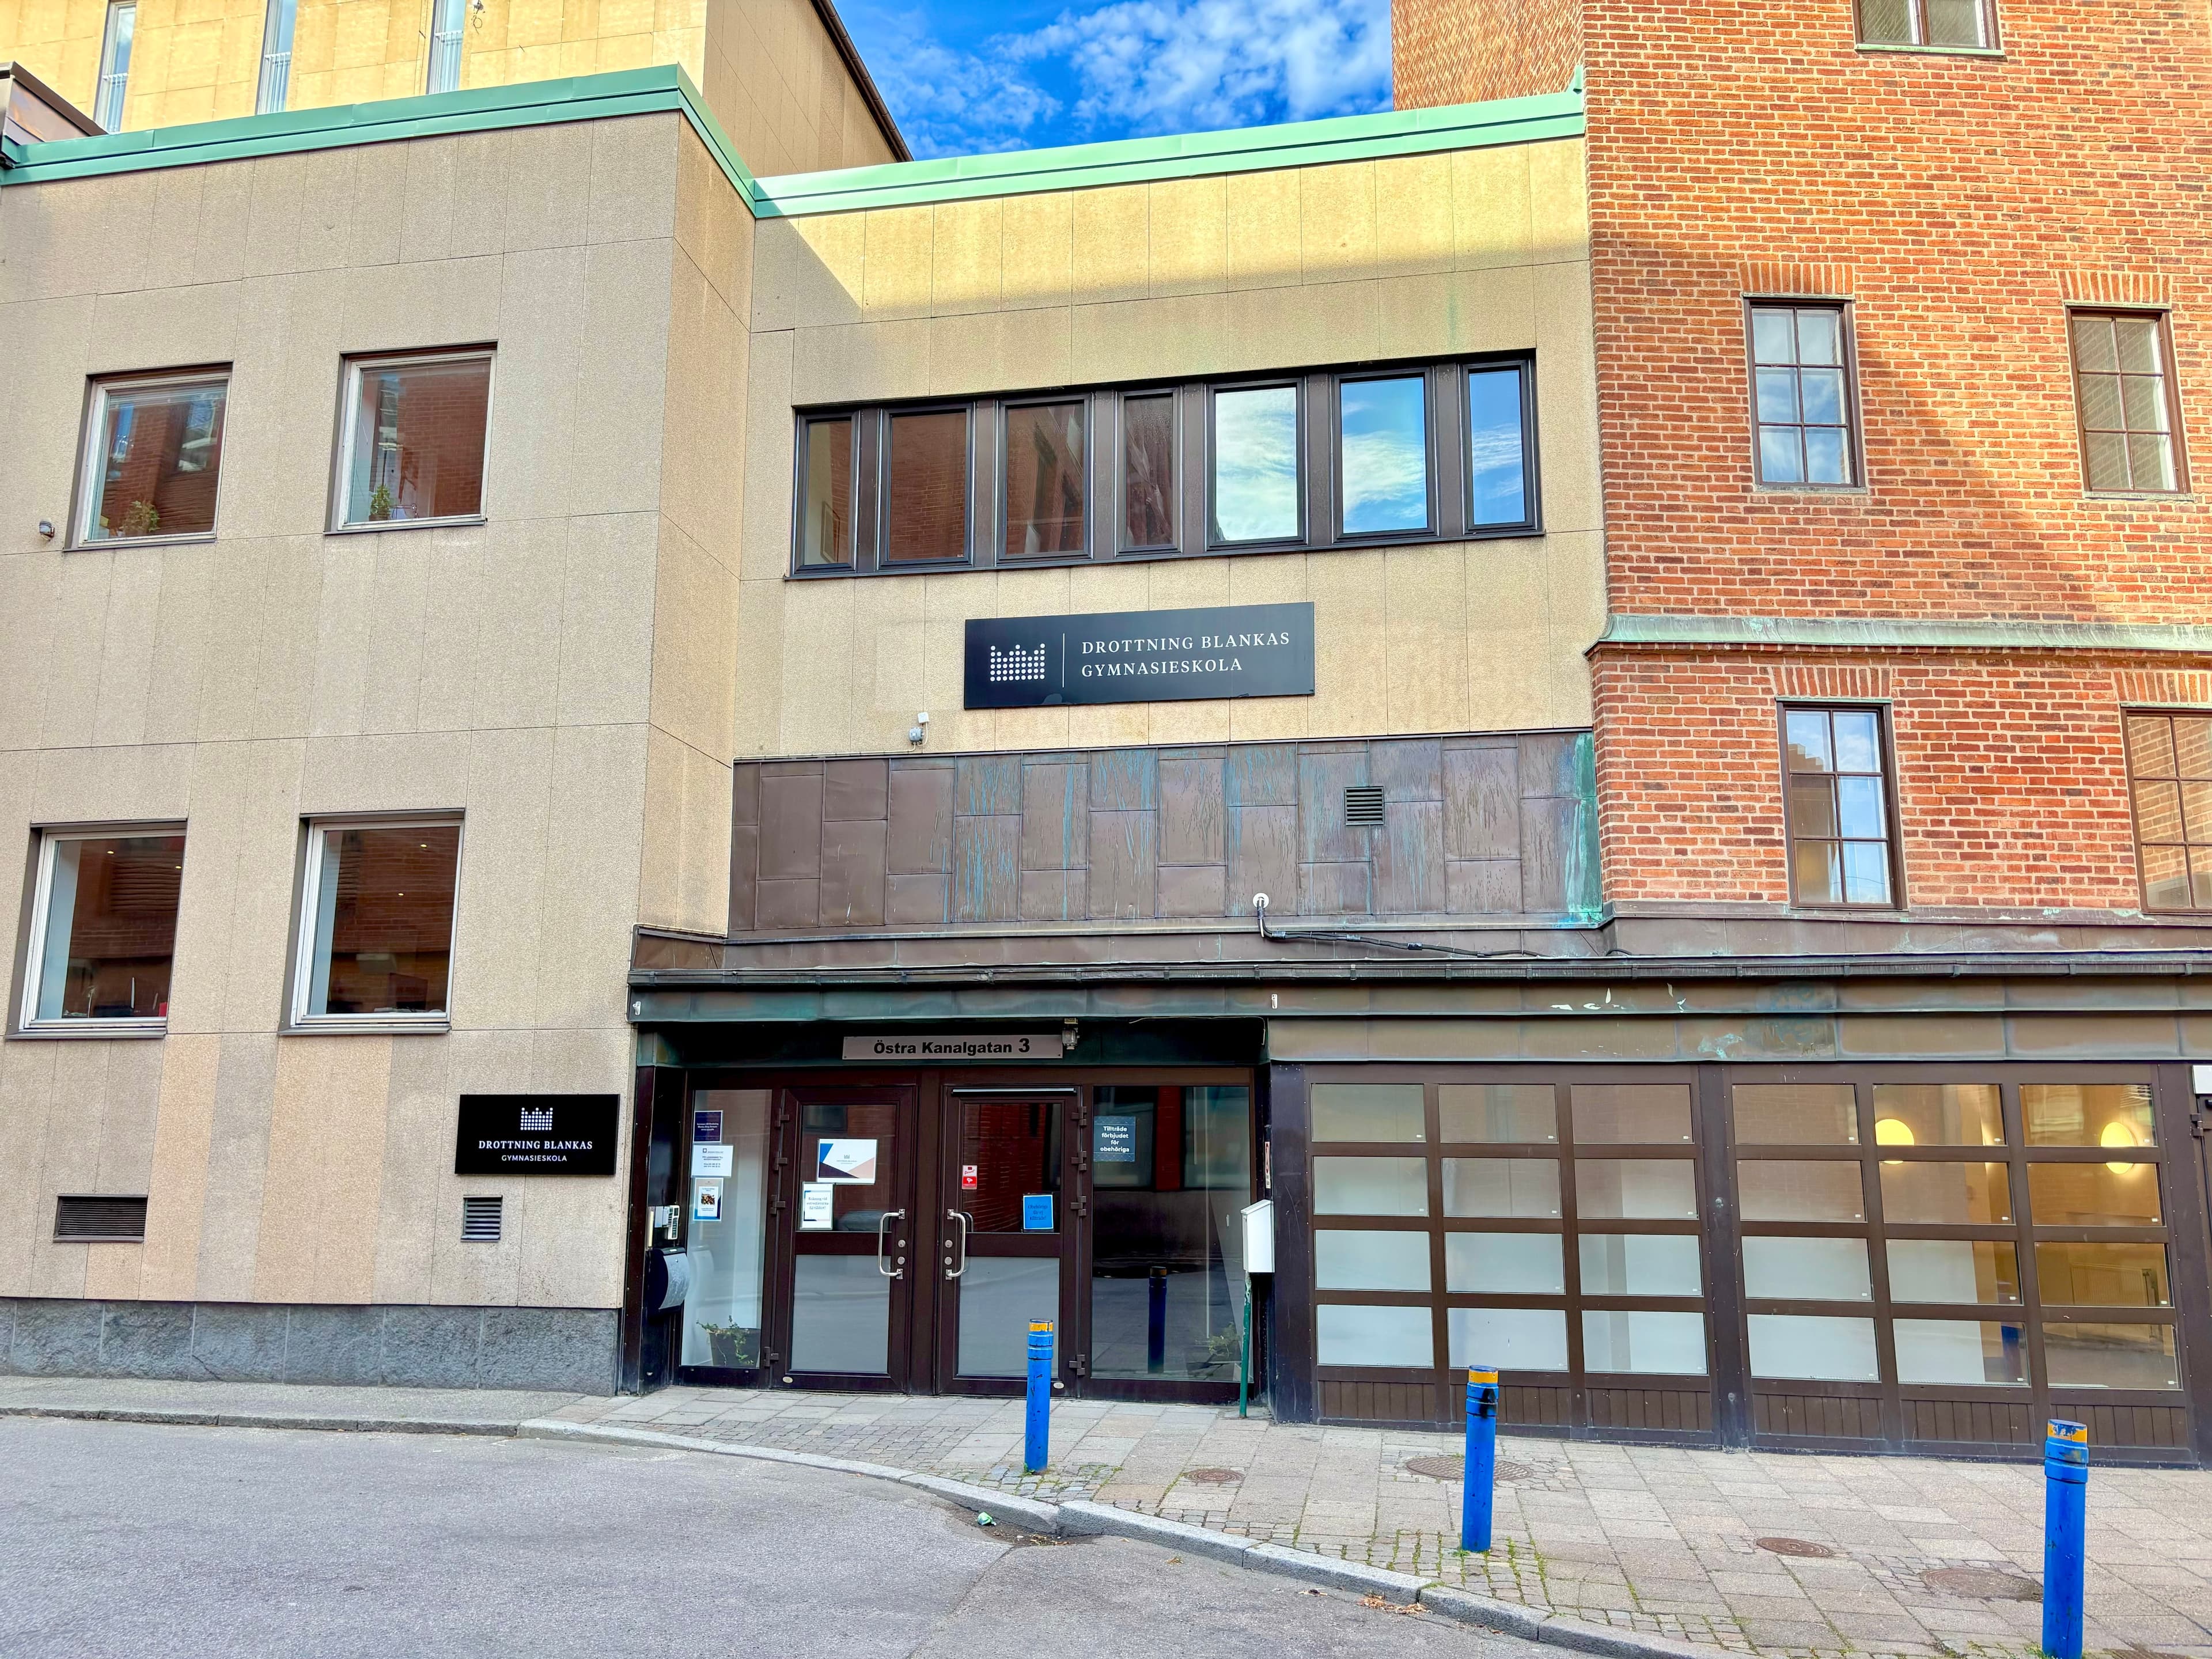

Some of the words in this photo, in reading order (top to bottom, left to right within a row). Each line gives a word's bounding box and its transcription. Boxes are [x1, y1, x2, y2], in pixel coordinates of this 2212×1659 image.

[1082, 637, 1194, 654] DROTTNING
[1200, 631, 1290, 650] BLANKAS
[1081, 657, 1243, 678] GYMNASIESKOLA
[873, 1039, 916, 1055] Östra
[922, 1041, 1013, 1056] Kanalgatan
[1018, 1037, 1031, 1053] 3
[478, 1140, 541, 1149] DROTTNING
[544, 1141, 593, 1150] BLANKAS
